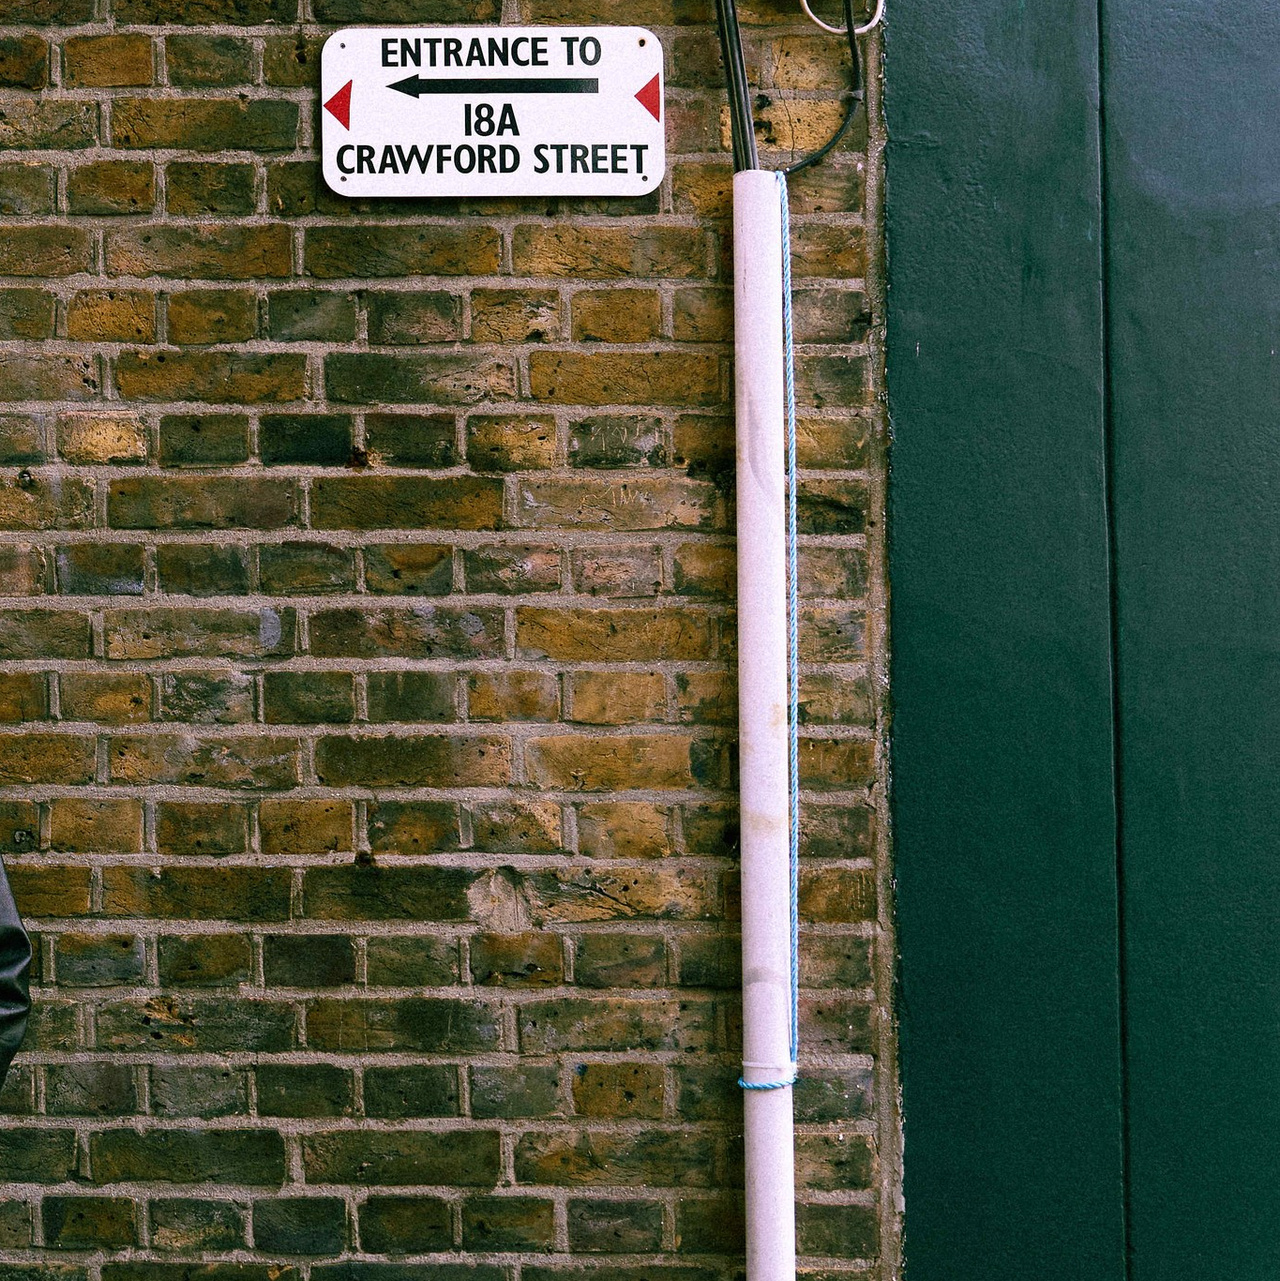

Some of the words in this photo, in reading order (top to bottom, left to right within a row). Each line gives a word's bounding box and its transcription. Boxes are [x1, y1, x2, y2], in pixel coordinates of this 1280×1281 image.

[381, 37, 548, 67] ENTRANCE
[561, 36, 602, 66] TO
[464, 103, 520, 136] 18A
[336, 144, 521, 174] CRAWFORD
[533, 144, 649, 174] STREET
